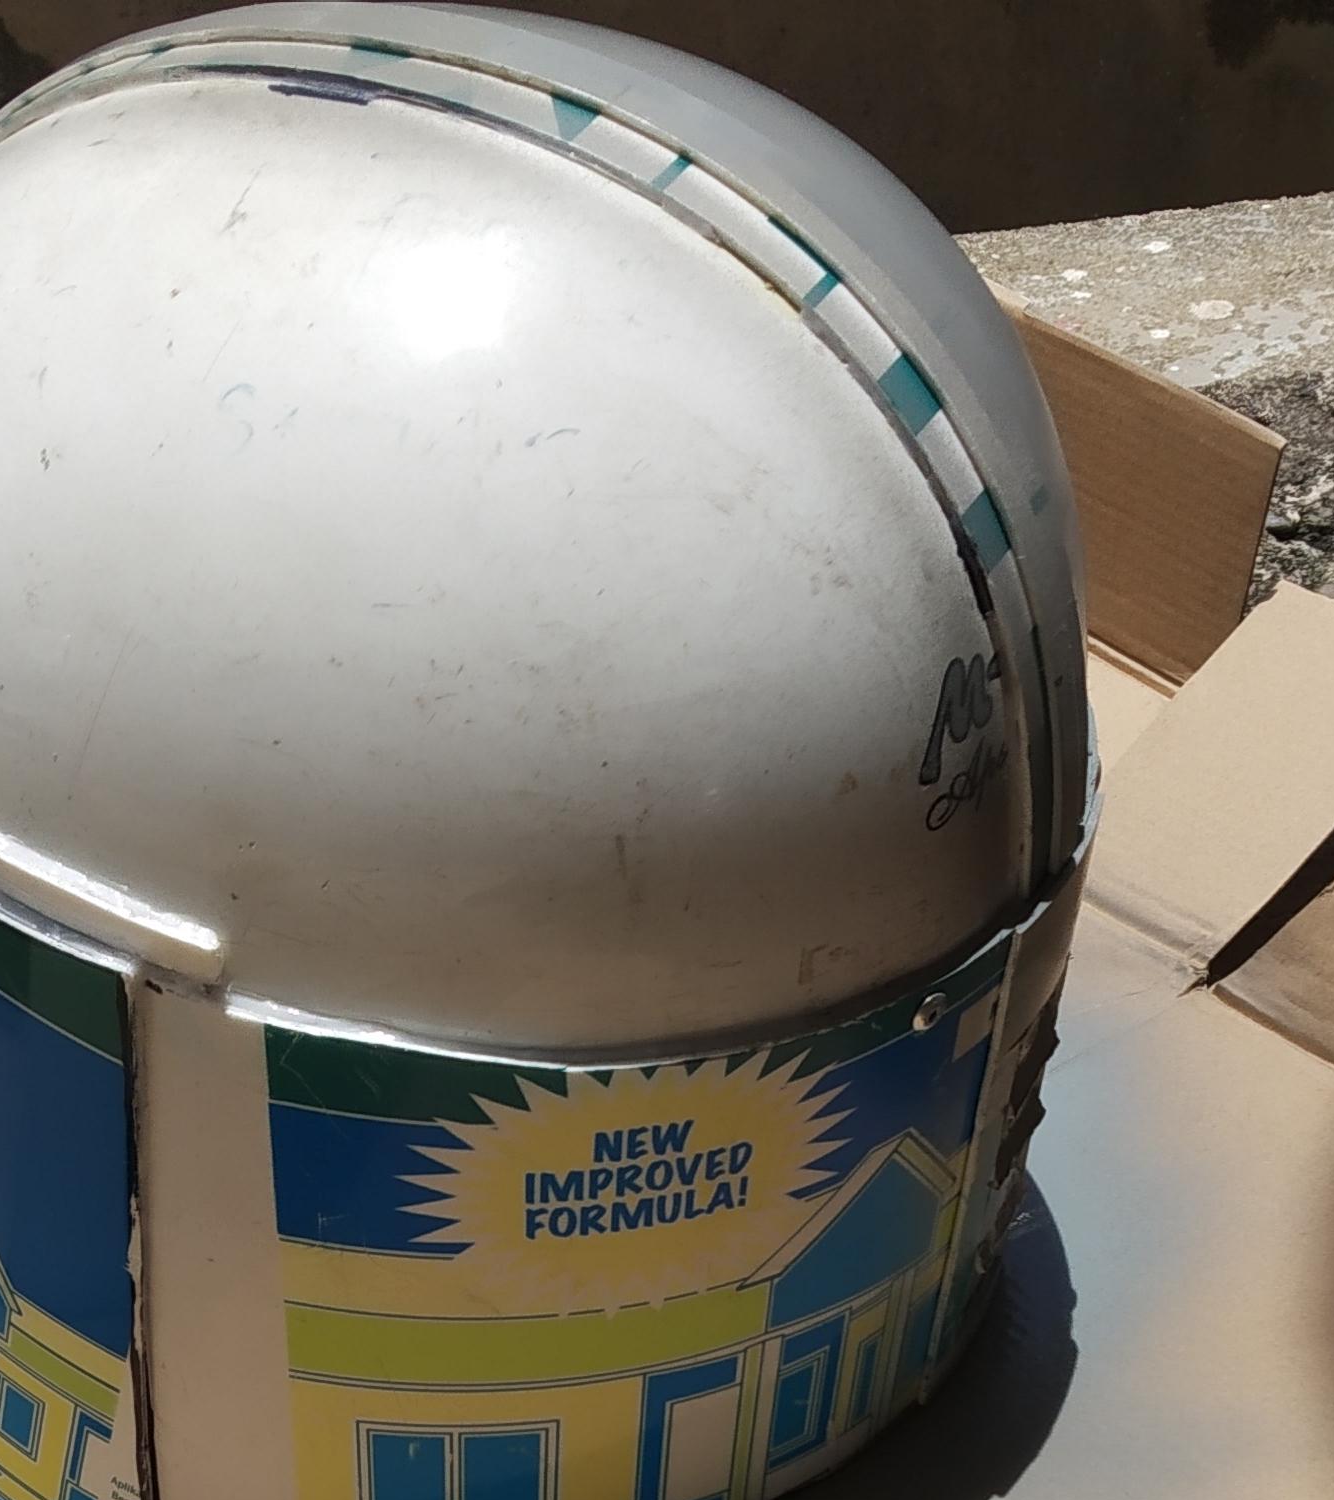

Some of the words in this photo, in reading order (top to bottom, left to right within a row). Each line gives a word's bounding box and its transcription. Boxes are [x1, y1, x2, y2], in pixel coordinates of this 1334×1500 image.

[524, 1141, 753, 1204] IMPROVED
[593, 1119, 695, 1163] NEW
[525, 1175, 749, 1239] FORMULA!
